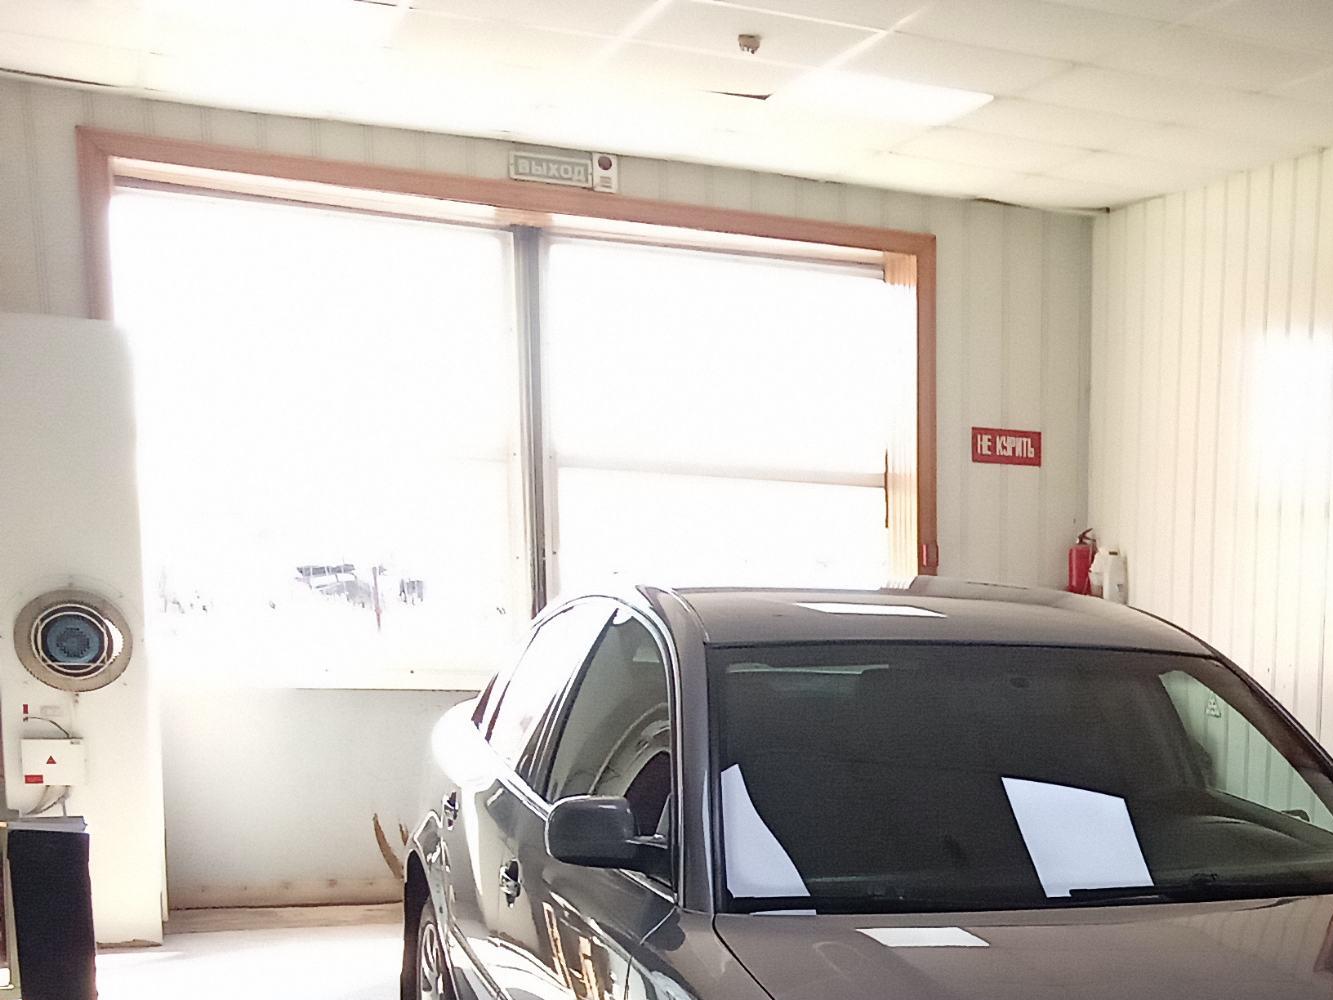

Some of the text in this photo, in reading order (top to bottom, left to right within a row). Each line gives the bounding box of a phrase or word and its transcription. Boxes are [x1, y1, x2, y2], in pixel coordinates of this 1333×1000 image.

[518, 159, 586, 182] ВЫХОД
[977, 434, 1035, 458] НЕ КУРИТЬ
